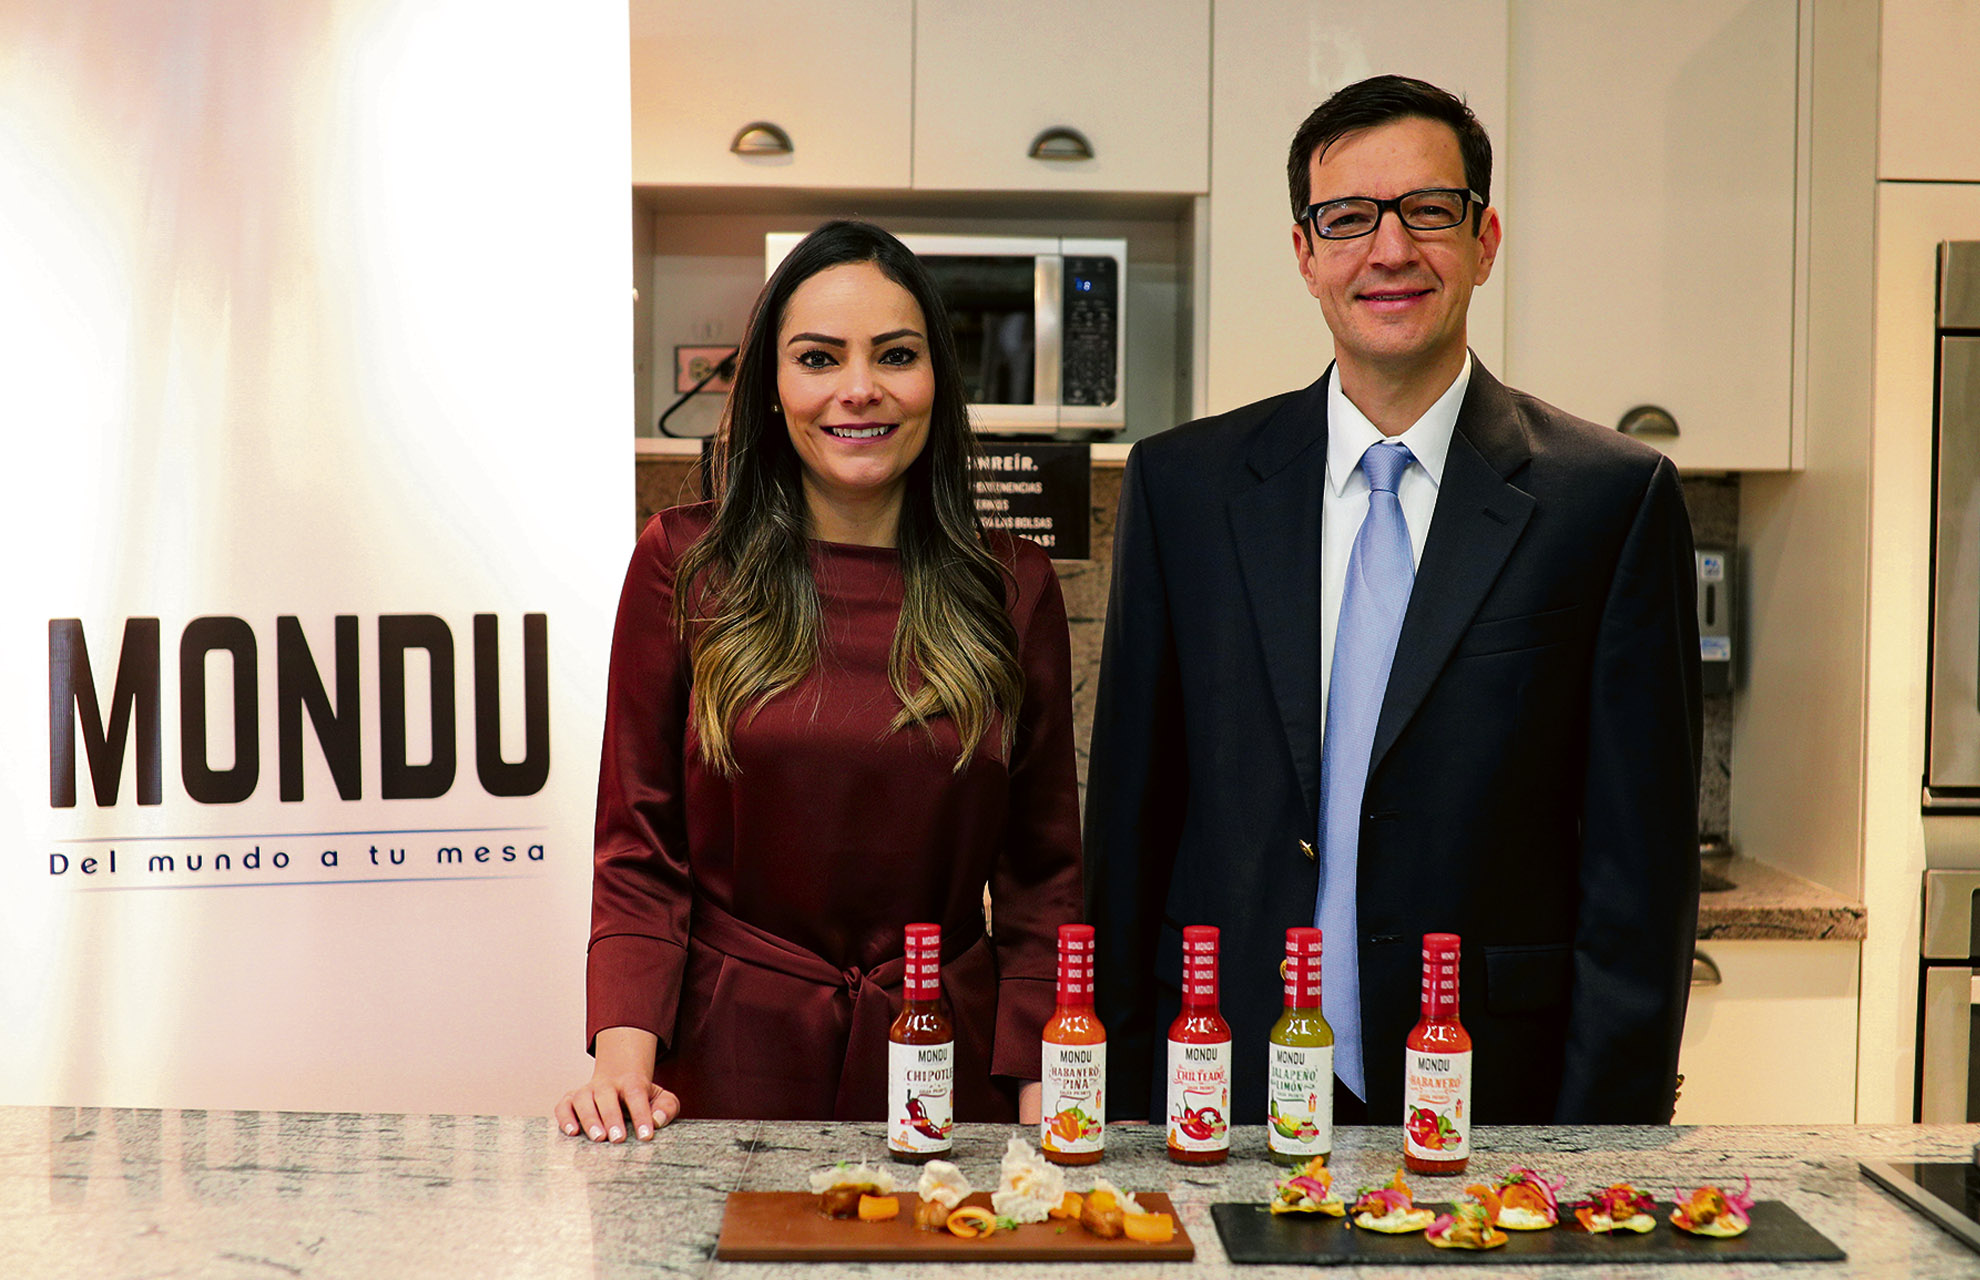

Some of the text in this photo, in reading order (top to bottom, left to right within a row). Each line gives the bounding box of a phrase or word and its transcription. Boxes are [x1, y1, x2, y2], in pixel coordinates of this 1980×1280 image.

[967, 453, 1039, 471] NREÍR.
[976, 481, 1042, 494] ERTENENCIAS
[1015, 516, 1053, 529] BOLSAS
[48, 613, 551, 808] MONDU
[49, 844, 545, 875] Del mundo a tu mesa
[918, 1048, 948, 1062] MONDU
[1060, 1050, 1092, 1063] MONDU
[1186, 1048, 1218, 1061] MONDU
[1277, 1050, 1305, 1065] MONDU
[1418, 1057, 1450, 1071] MONDU
[1051, 1066, 1100, 1078] HABANERO
[1409, 1074, 1460, 1089] HABANERO
